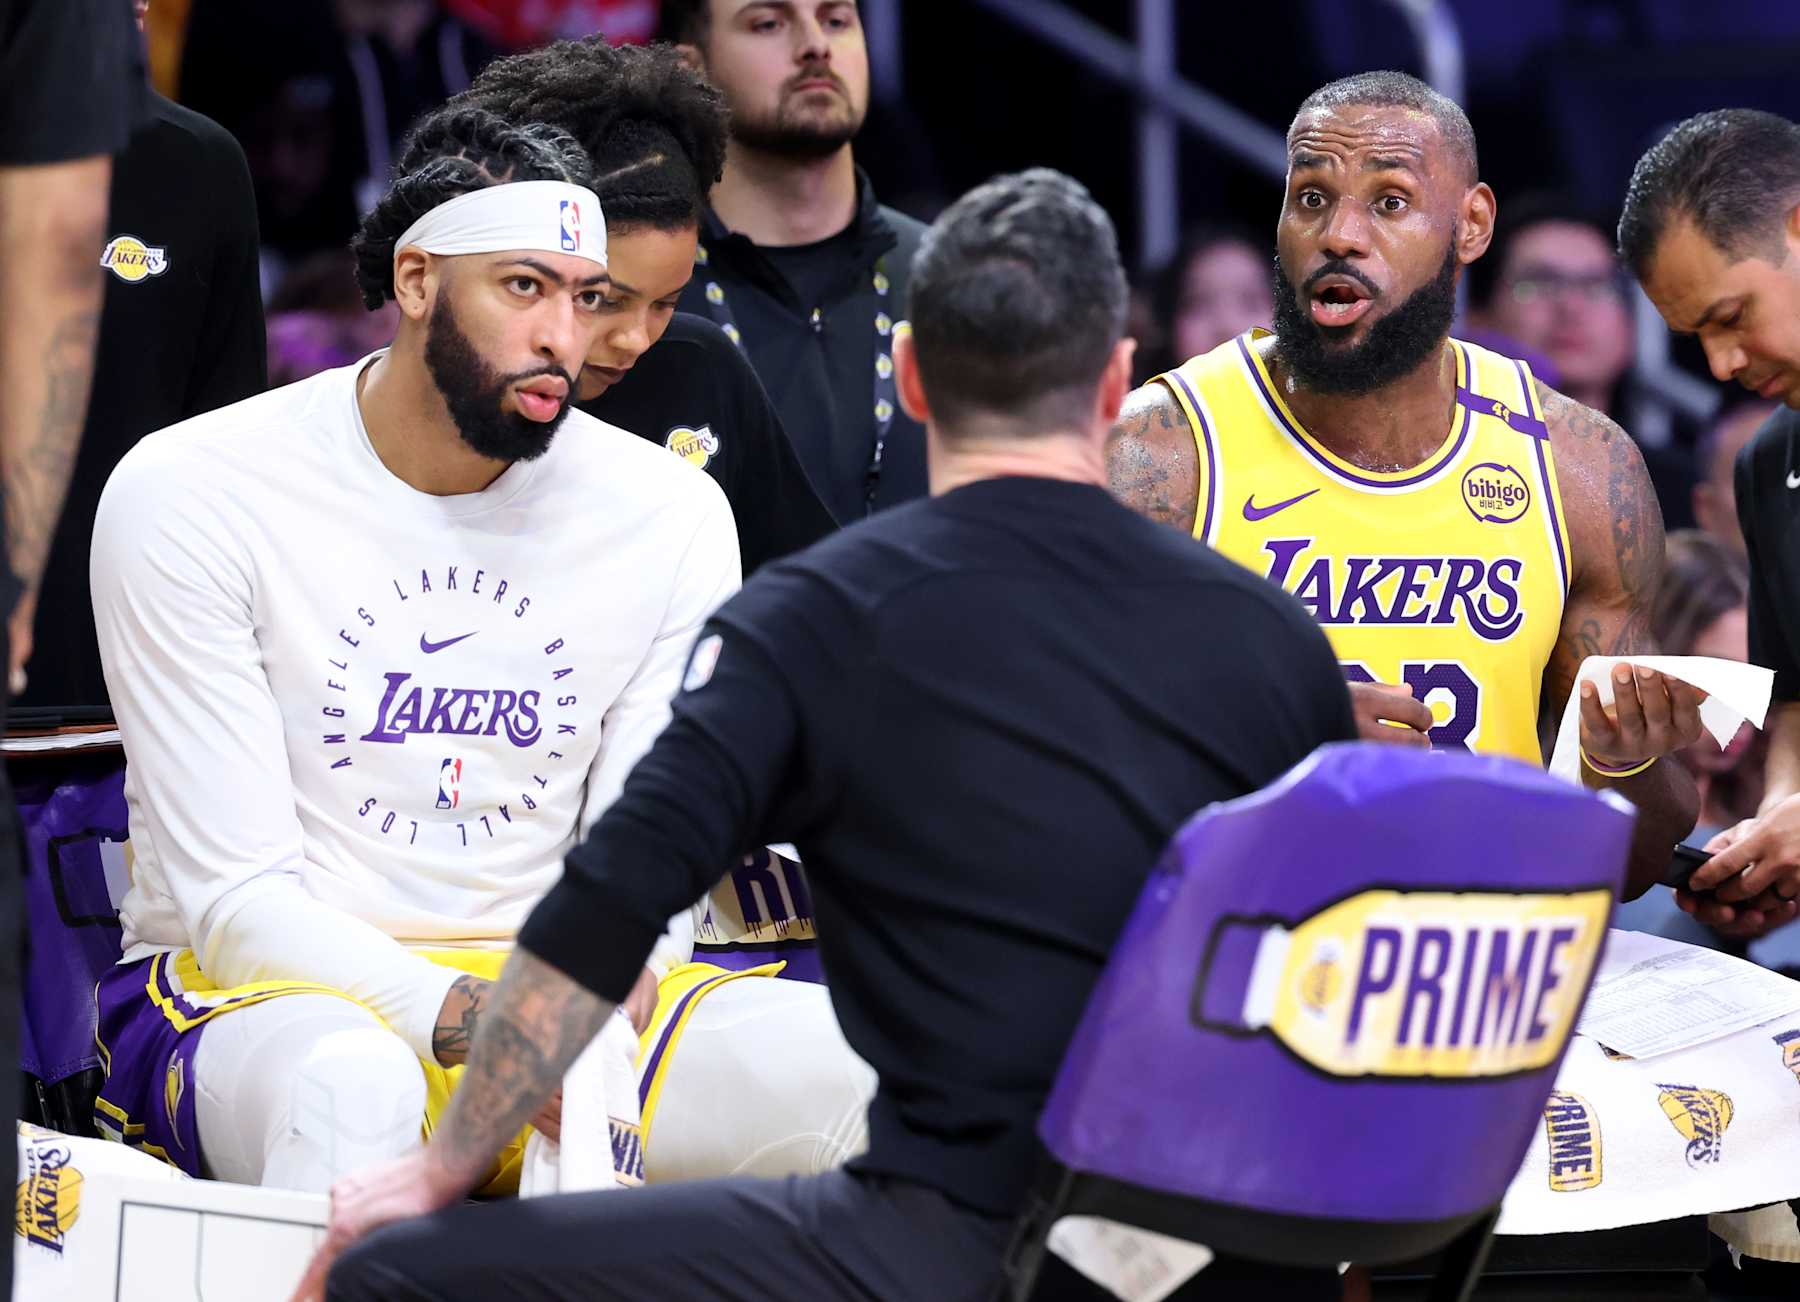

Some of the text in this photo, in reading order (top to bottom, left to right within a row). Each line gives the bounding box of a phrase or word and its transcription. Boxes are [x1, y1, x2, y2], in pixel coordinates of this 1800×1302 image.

[105, 246, 162, 271] LAKERS
[1467, 478, 1525, 506] bibigo
[1479, 499, 1504, 510] 비비고
[393, 566, 531, 618] LAKERS
[322, 606, 376, 770] ANGELES
[359, 672, 543, 748] LAKERS
[358, 797, 418, 845] LOS
[1344, 927, 1576, 1046] PRIME
[28, 1146, 72, 1254] LAKERS
